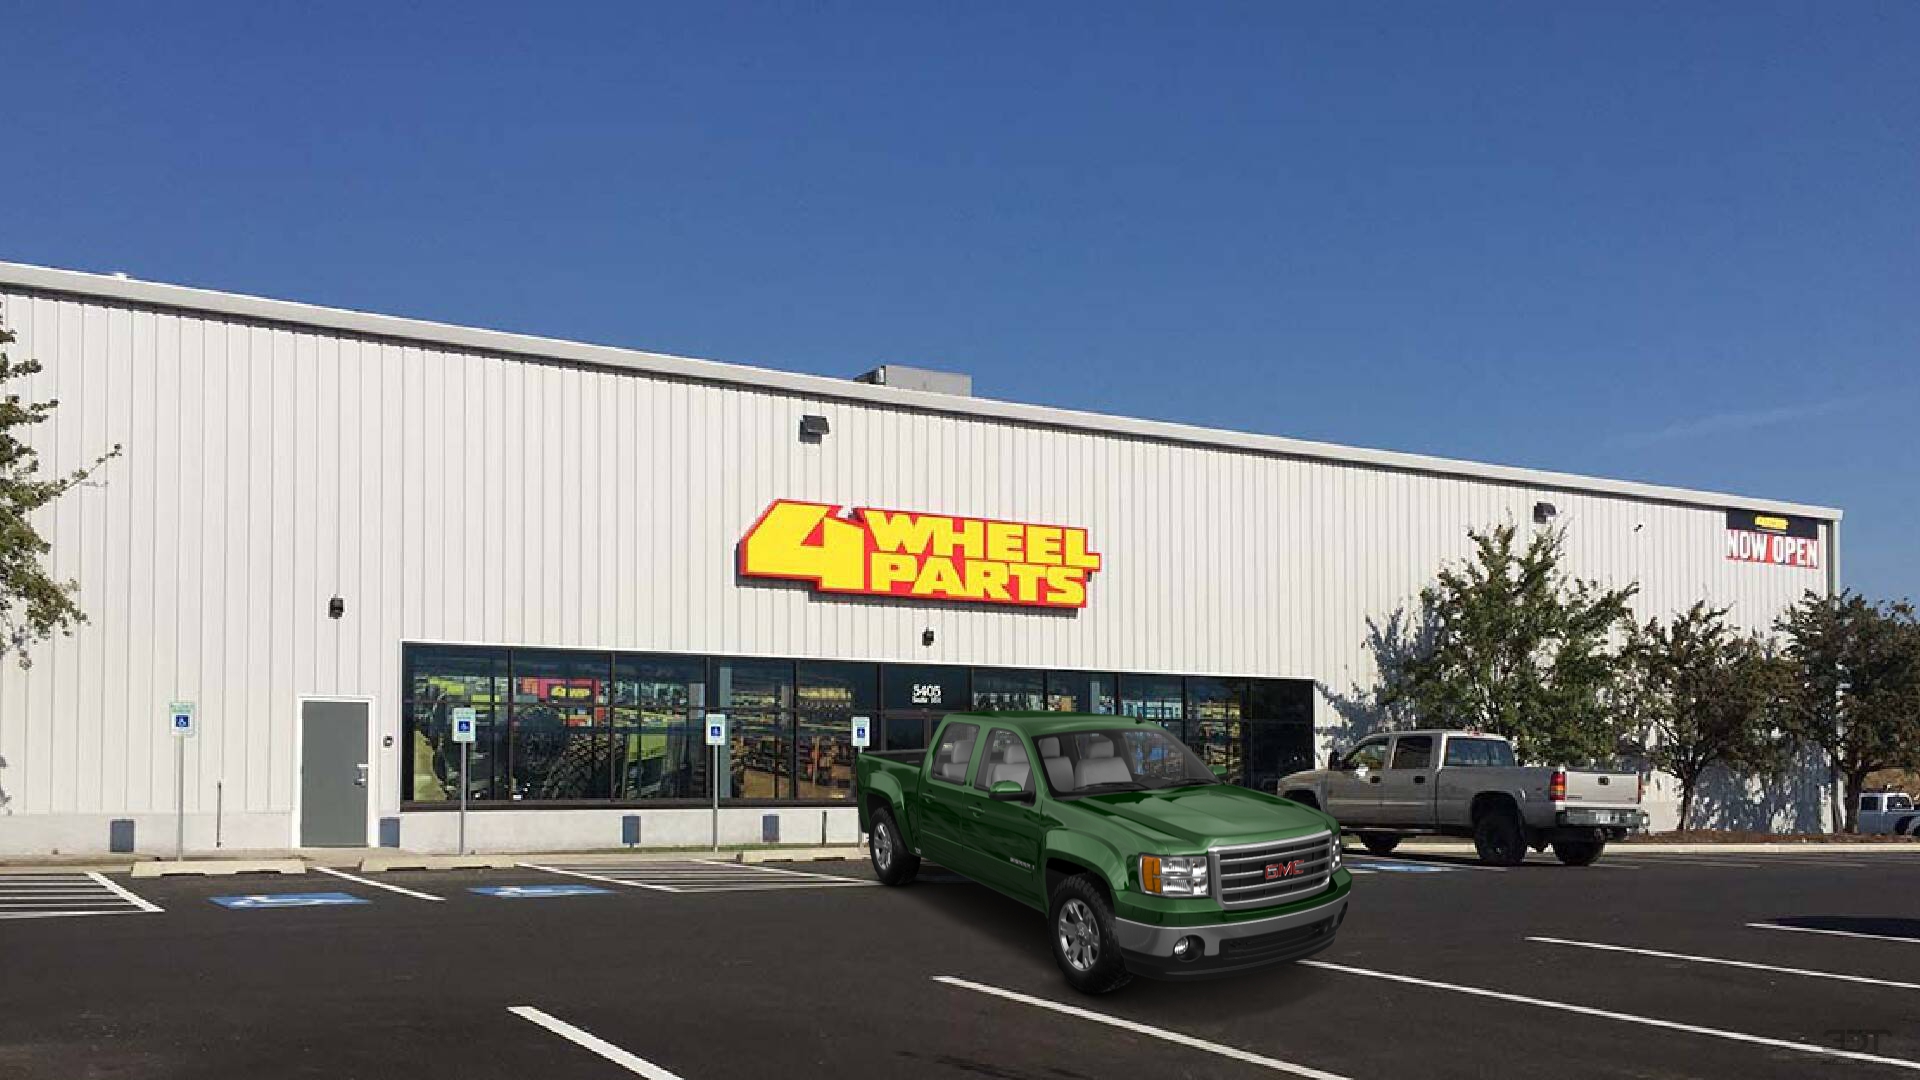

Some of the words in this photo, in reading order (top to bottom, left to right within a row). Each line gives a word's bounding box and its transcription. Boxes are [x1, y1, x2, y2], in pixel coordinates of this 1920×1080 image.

[747, 502, 865, 591] 4
[863, 510, 1100, 568] WHEEL
[1727, 530, 1769, 562] NOW
[1773, 536, 1818, 568] OPEN
[871, 552, 1086, 605] PARTS
[1265, 859, 1305, 880] GMC
